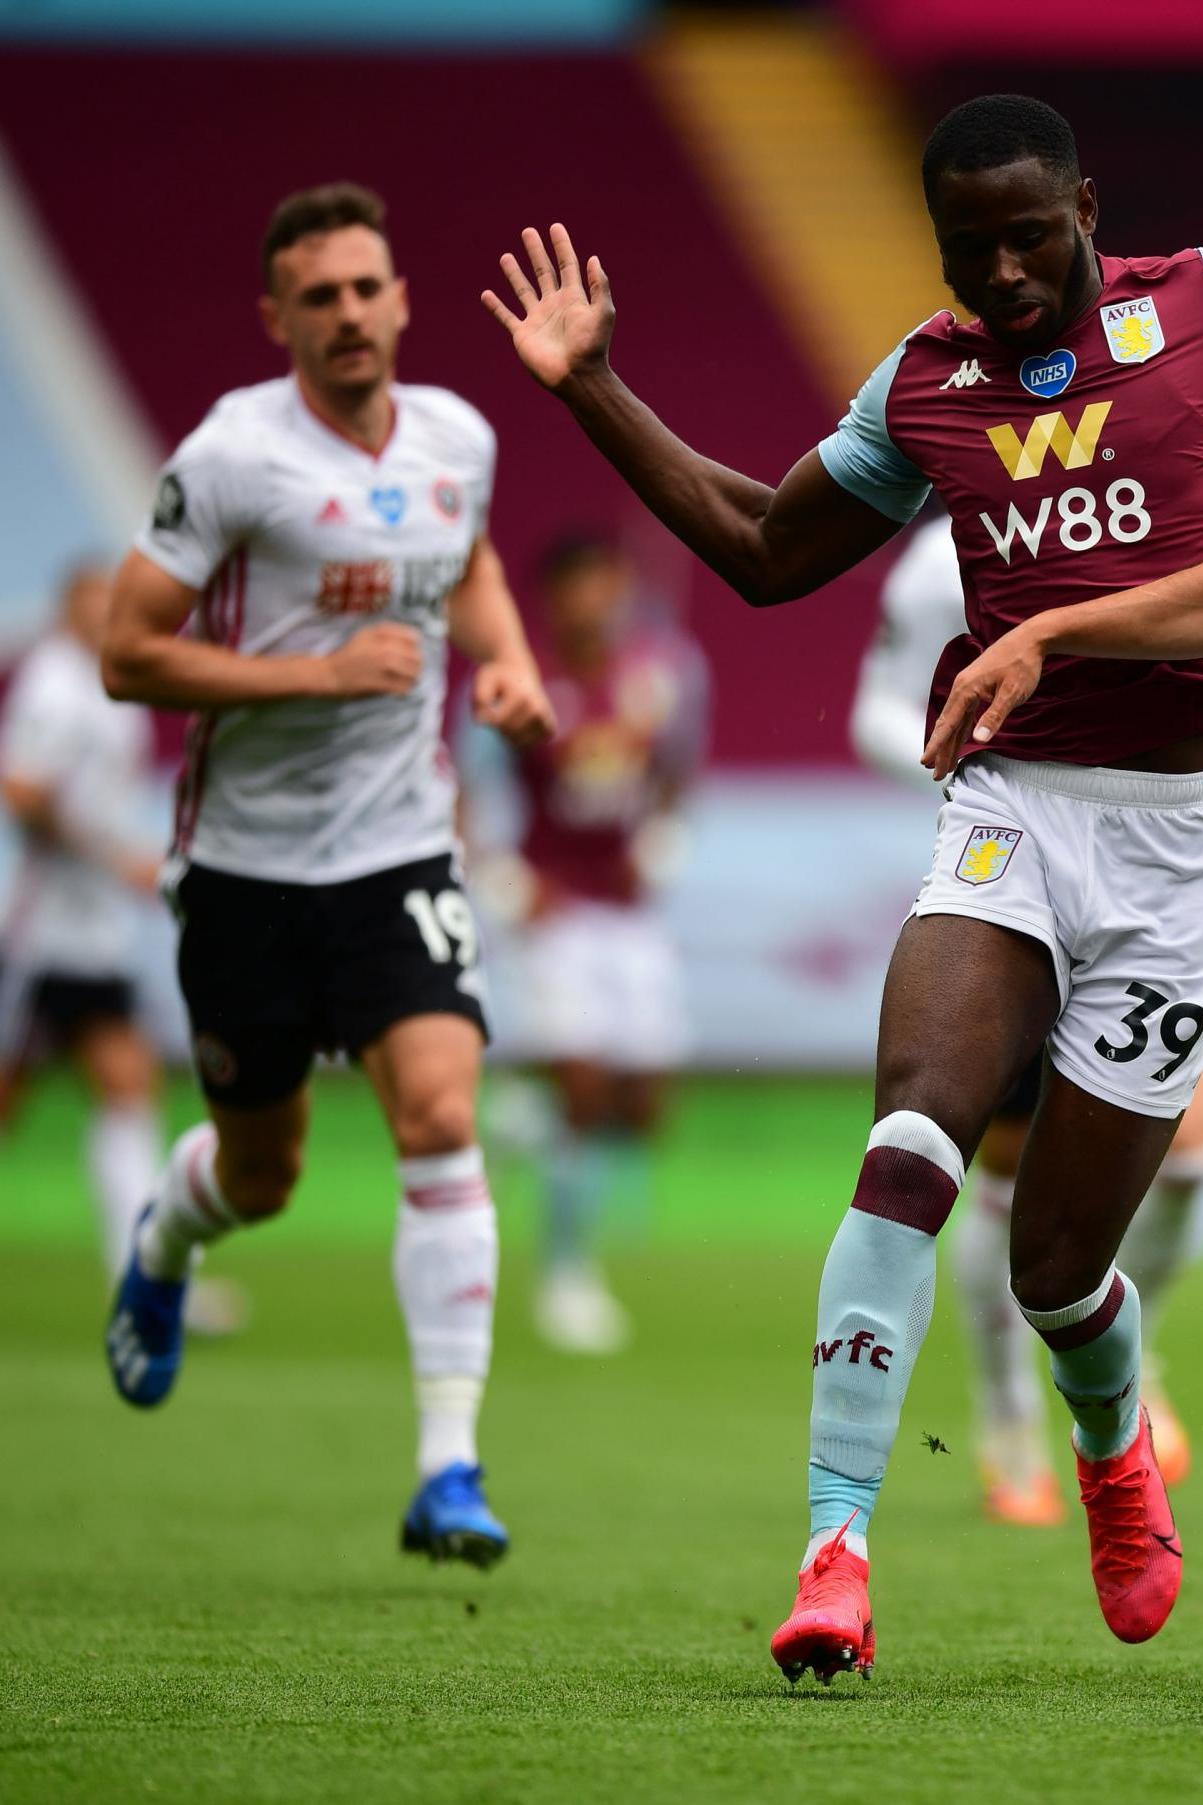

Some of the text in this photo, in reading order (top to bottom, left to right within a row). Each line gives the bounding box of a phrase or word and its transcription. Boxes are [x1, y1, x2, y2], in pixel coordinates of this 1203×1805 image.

[1107, 301, 1150, 321] AVFC
[1032, 364, 1065, 386] NHS
[978, 477, 1152, 566] W88
[973, 829, 1018, 842] AVFC
[404, 889, 478, 966] 19
